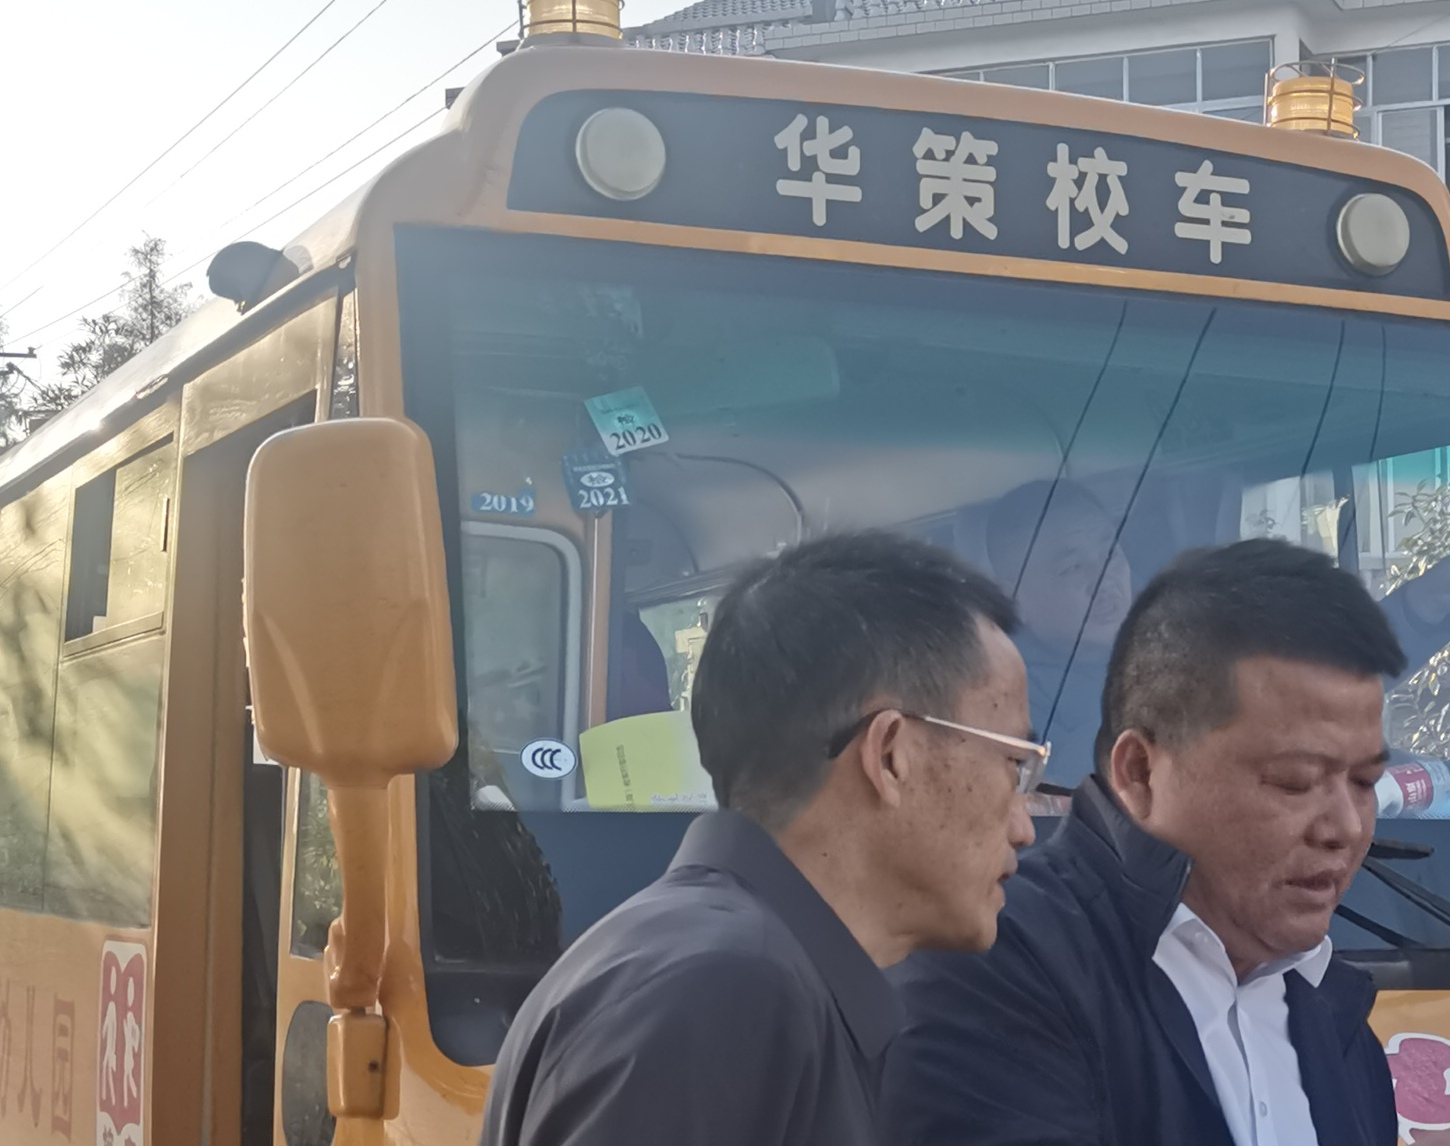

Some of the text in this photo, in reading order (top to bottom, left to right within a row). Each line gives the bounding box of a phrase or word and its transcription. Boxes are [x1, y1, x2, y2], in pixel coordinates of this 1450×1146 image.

[773, 113, 1252, 264] 华策校车
[610, 422, 662, 450] 2020
[480, 492, 535, 512] 2019
[577, 486, 630, 509] 2021
